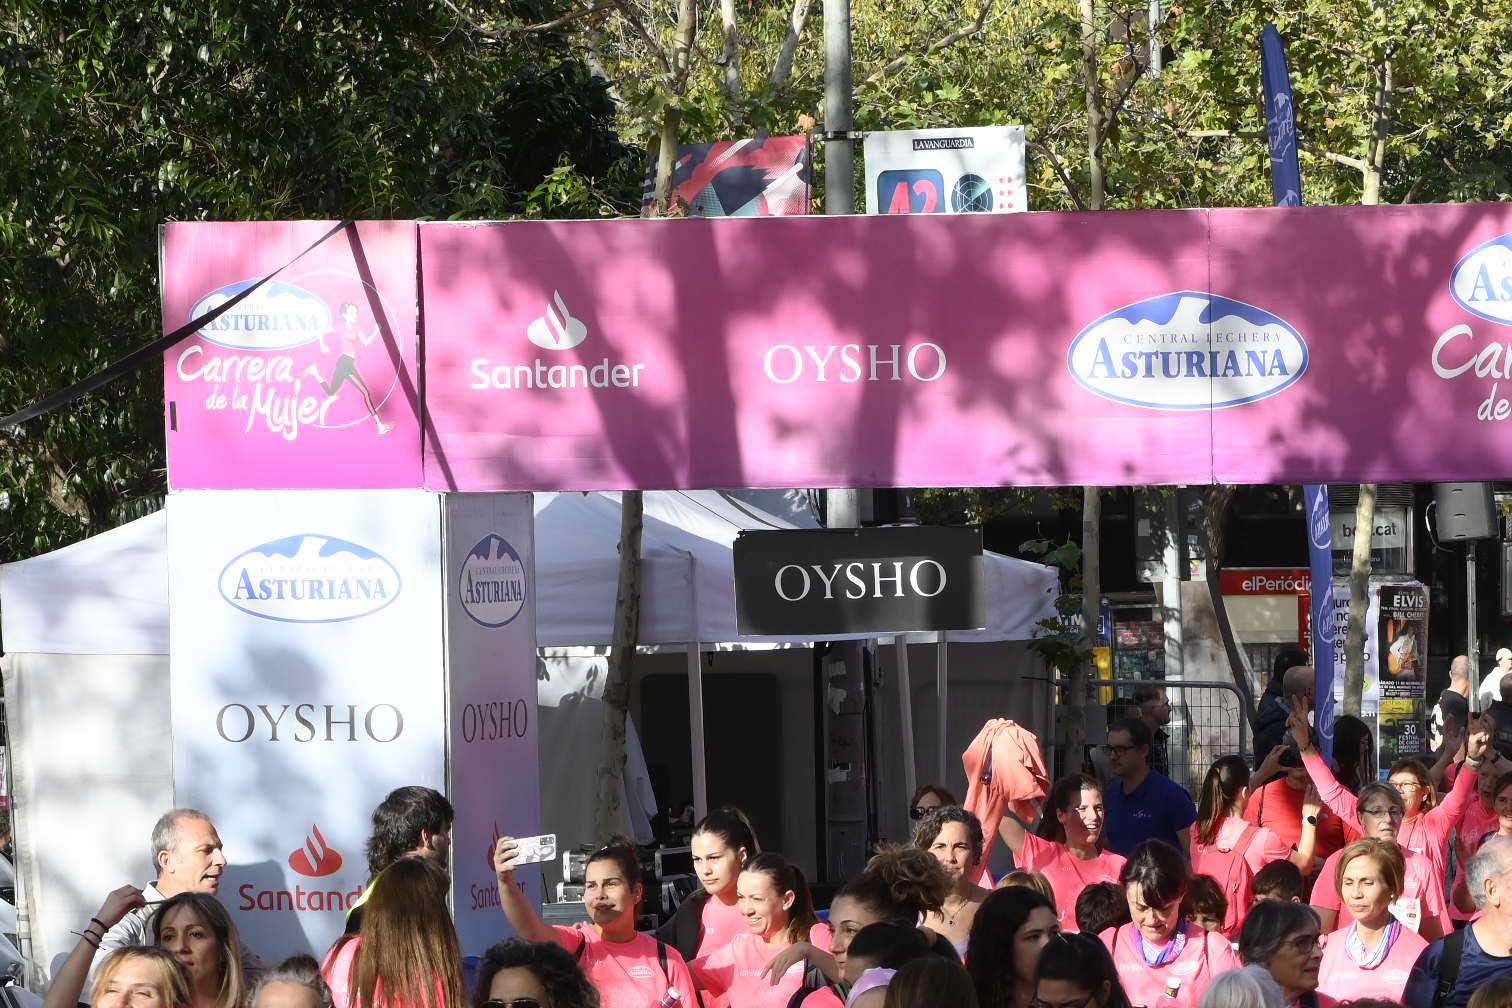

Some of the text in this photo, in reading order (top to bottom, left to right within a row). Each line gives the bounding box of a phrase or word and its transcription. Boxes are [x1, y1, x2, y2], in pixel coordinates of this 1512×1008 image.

[924, 138, 974, 149] VANGUARDIA
[1123, 331, 1281, 345] CENTRAL LECHERA
[176, 345, 294, 384] Carrera
[470, 357, 645, 391] Santander
[764, 341, 948, 385] OYSHO
[1087, 337, 1290, 380] ASTURIANA
[205, 379, 339, 441] de la Mujer
[1476, 382, 1512, 421] de
[234, 567, 387, 601] ASTURIANA
[464, 566, 523, 604] ASTURIANA
[774, 559, 948, 602] OYSHO
[1393, 594, 1424, 608] ELVIS
[216, 702, 405, 743] OYSHO
[462, 698, 528, 744] OYSHO
[1404, 724, 1416, 735] 30
